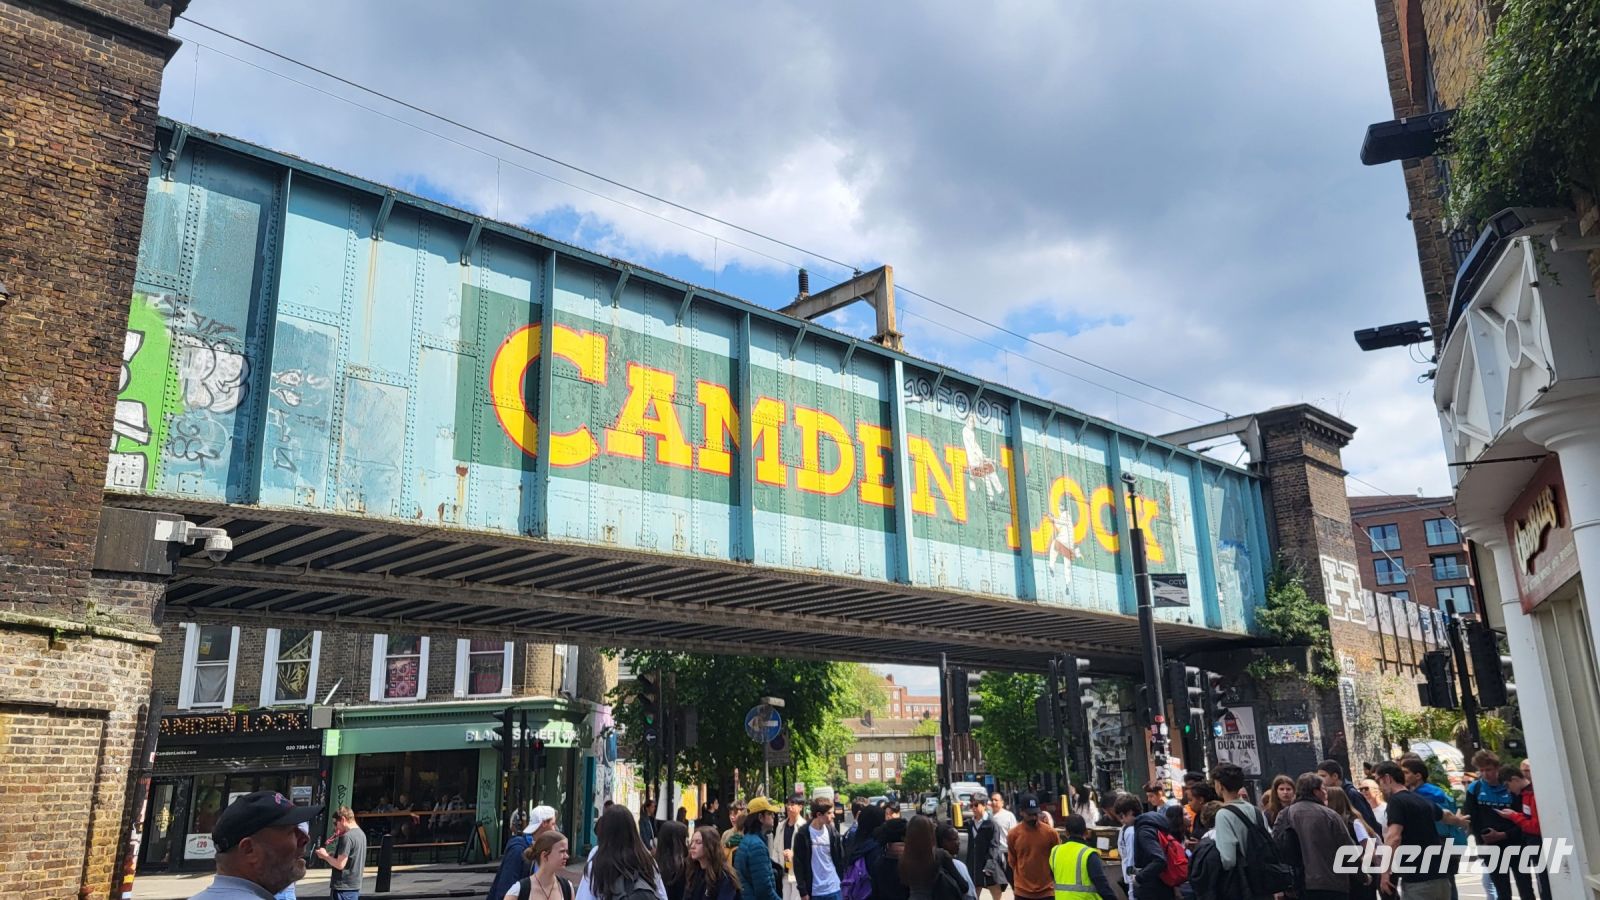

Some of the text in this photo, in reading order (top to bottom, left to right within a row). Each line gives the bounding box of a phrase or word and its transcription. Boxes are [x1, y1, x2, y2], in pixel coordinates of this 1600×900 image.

[489, 322, 1166, 563] CAMDEN LOCK
[159, 715, 237, 736] AMDEN
[465, 729, 503, 742] BLAN
[1218, 740, 1256, 750] DUA ZINE
